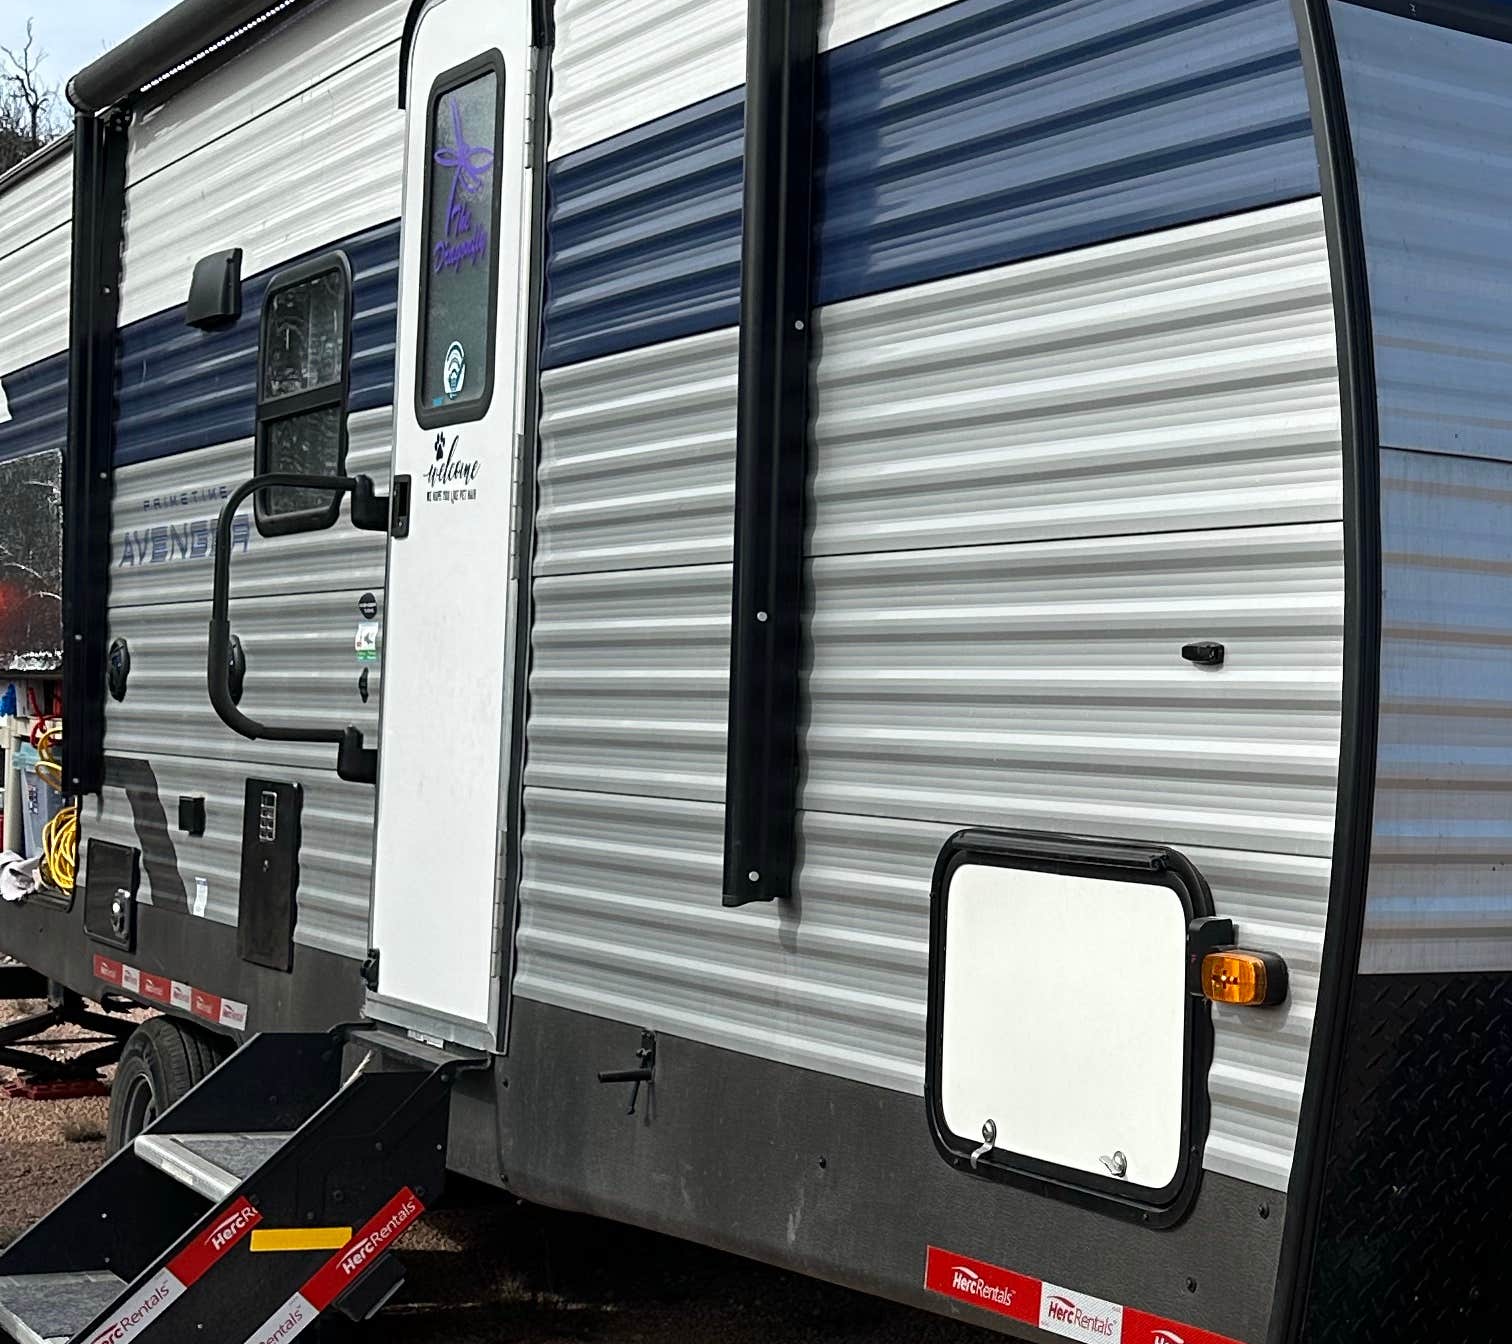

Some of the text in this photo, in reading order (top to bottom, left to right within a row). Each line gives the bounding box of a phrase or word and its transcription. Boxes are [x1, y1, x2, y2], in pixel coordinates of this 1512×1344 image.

[143, 485, 228, 512] PRIMETIME
[342, 1201, 416, 1275] HercRentals
[953, 1271, 1012, 1307] HercRentals
[1048, 1300, 1113, 1337] HercRentals
